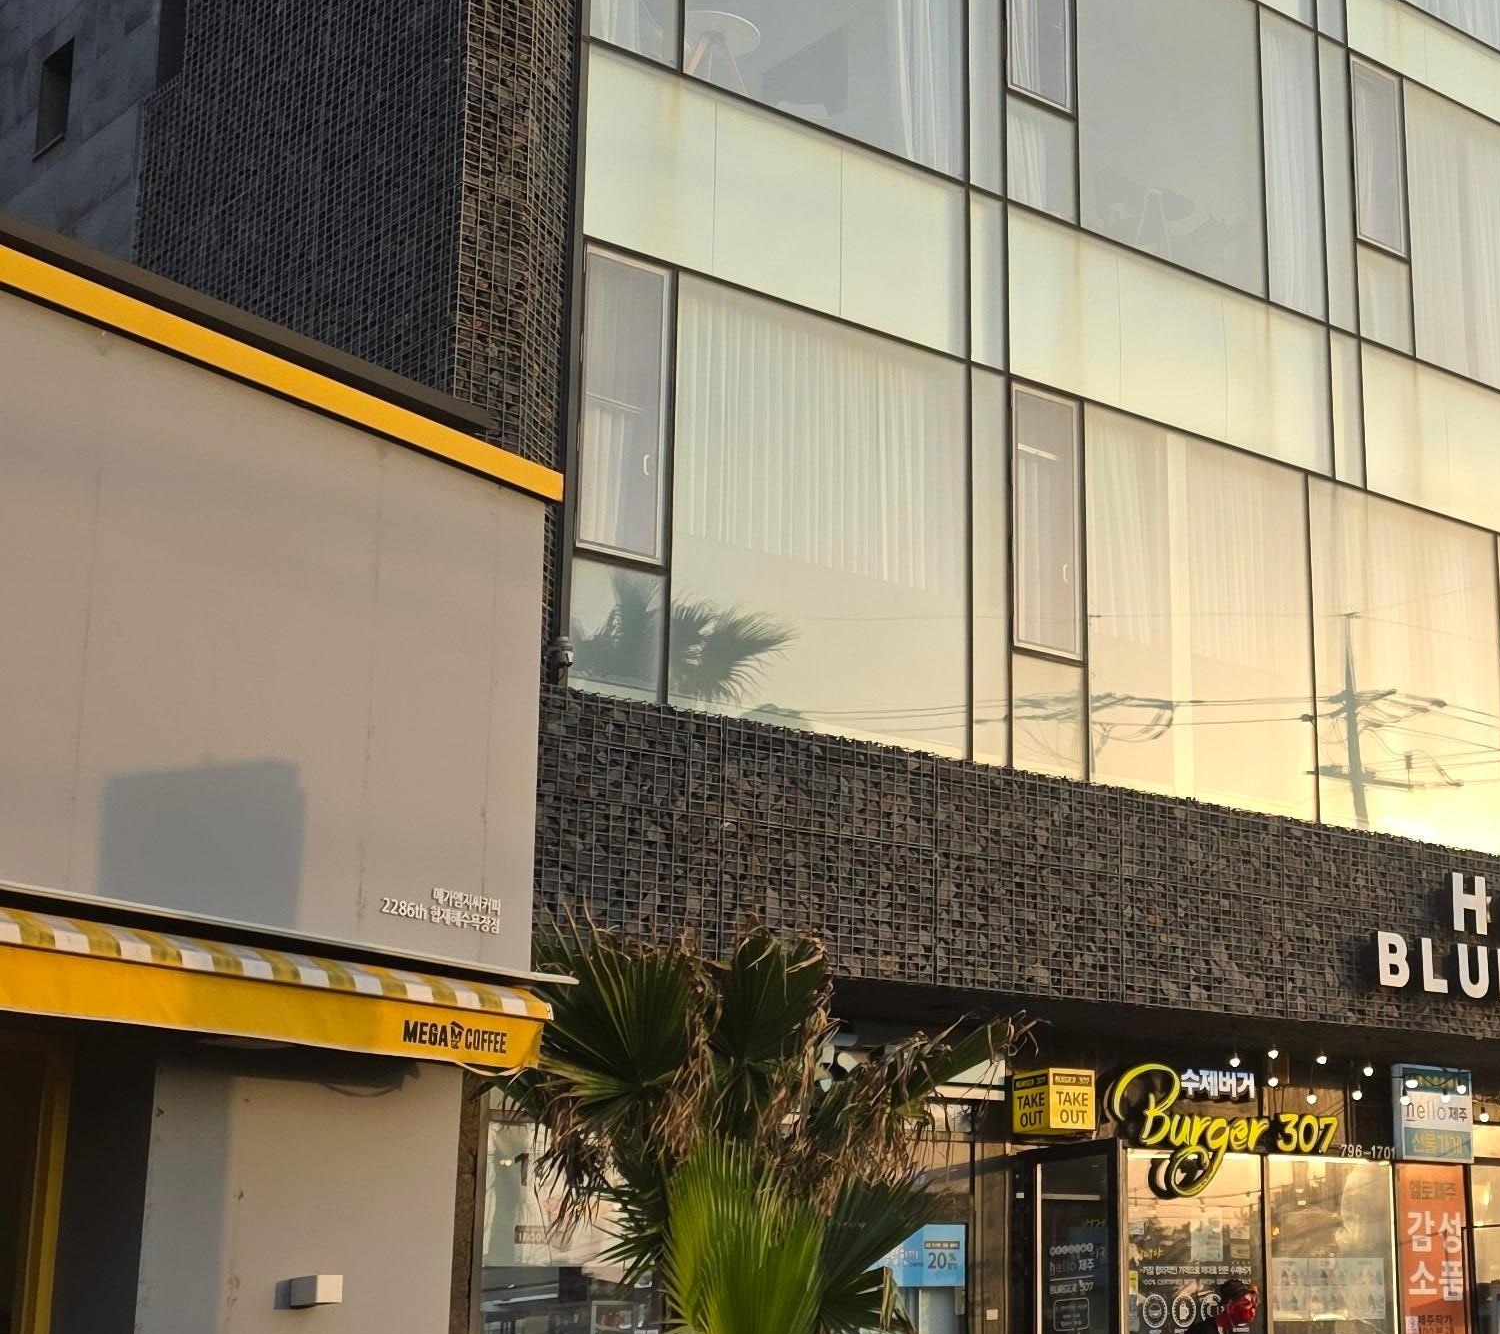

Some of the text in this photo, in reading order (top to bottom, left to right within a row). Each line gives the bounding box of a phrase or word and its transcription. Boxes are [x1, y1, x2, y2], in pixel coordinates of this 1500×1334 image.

[381, 896, 427, 920] 2286th
[432, 887, 500, 916] 메가엠지씨커피
[403, 1020, 448, 1047] MEGA
[464, 1028, 507, 1054] COFFEE
[1181, 1068, 1255, 1099] 수제버거
[1017, 1092, 1045, 1110] TAKE
[1056, 1090, 1089, 1107] TAKE
[1020, 1110, 1044, 1128] OUT
[1060, 1109, 1088, 1124] OUT
[1448, 1106, 1469, 1122] 제주
[1112, 1063, 1338, 1197] Burger 307
[1340, 1144, 1396, 1160] 796-1701
[1407, 1210, 1462, 1253] 감성
[928, 1252, 947, 1269] 20
[1408, 1260, 1464, 1301] 소품
